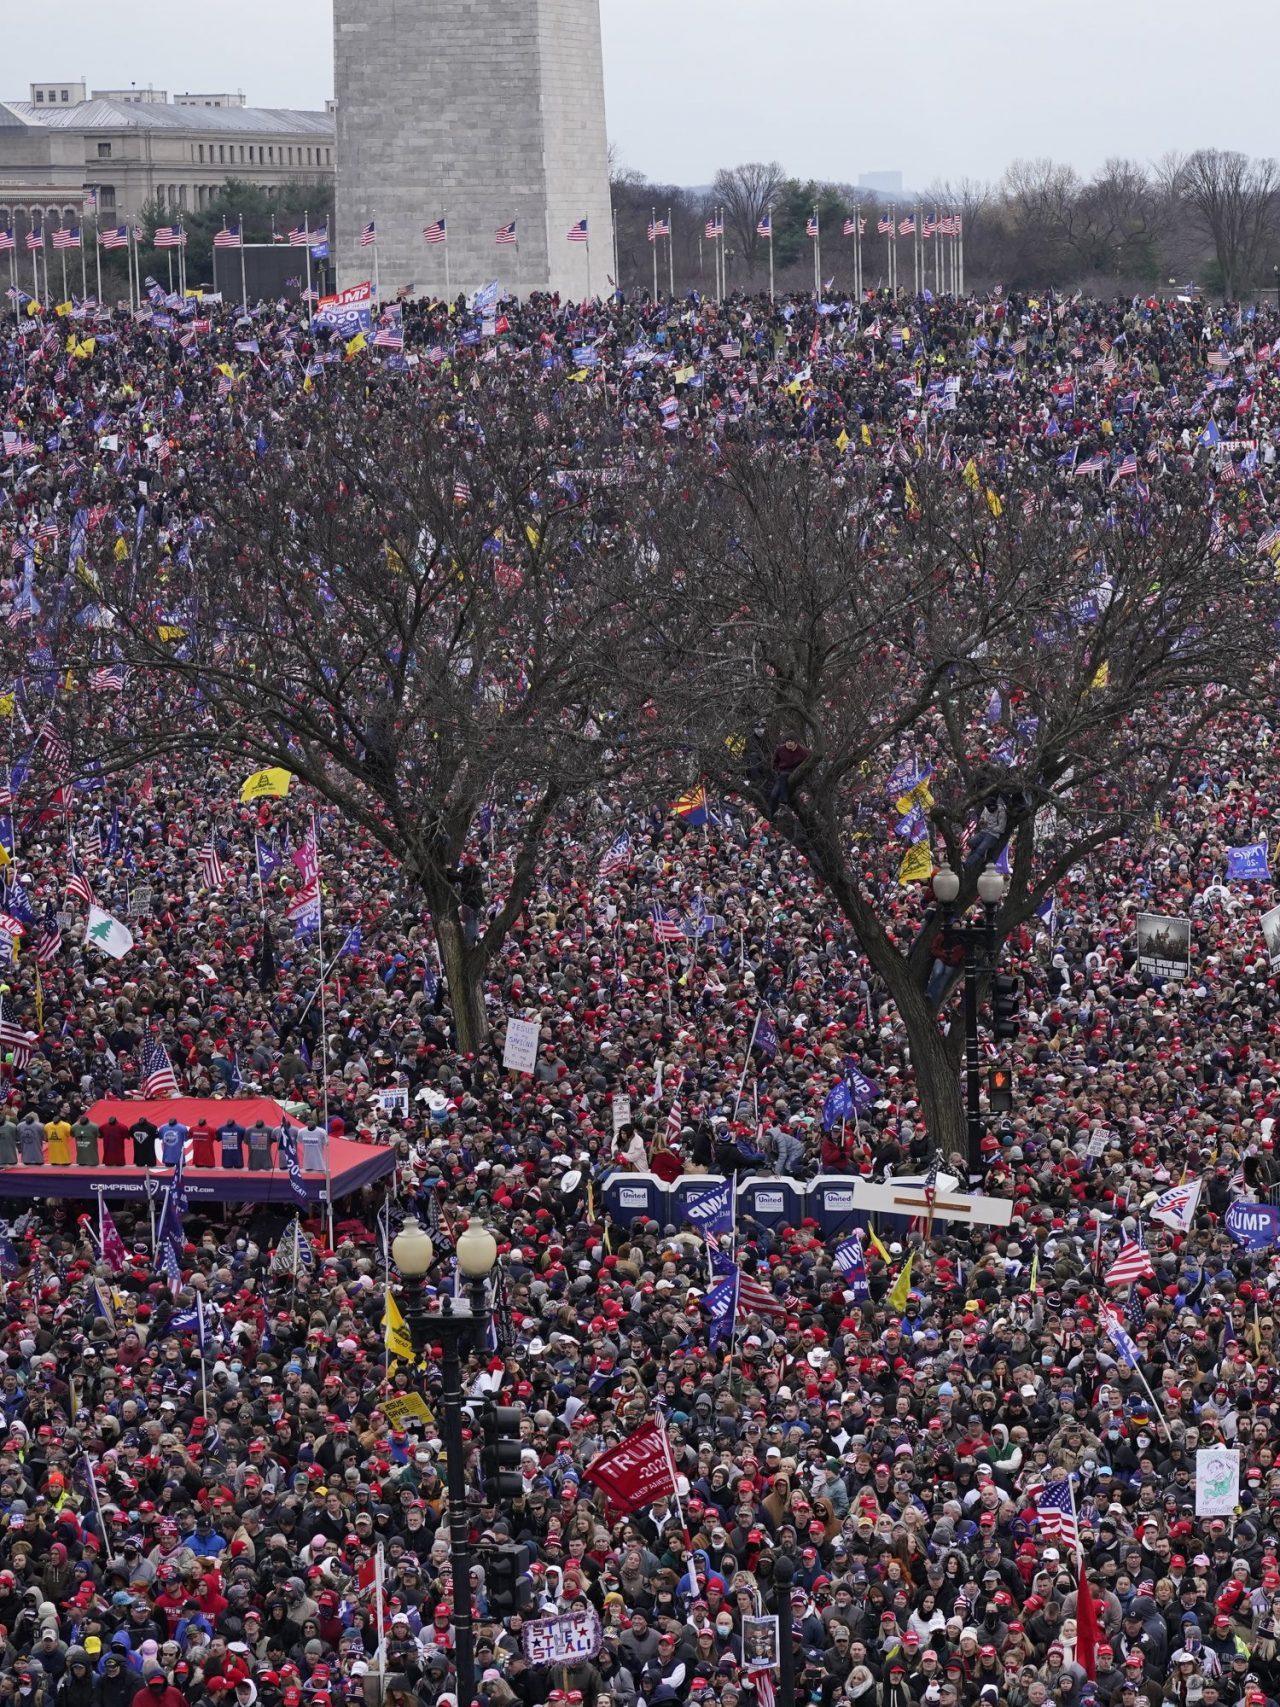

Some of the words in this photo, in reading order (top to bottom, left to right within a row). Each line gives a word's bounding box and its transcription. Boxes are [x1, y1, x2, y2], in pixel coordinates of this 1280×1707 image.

[385, 1399, 405, 1411] JESUS
[388, 1406, 410, 1419] SAVES
[598, 1429, 665, 1479] TRUM
[629, 1486, 649, 1501] KEEP
[532, 1618, 586, 1637] STOP
[542, 1630, 573, 1648] THE
[532, 1638, 591, 1660] STEAL!
